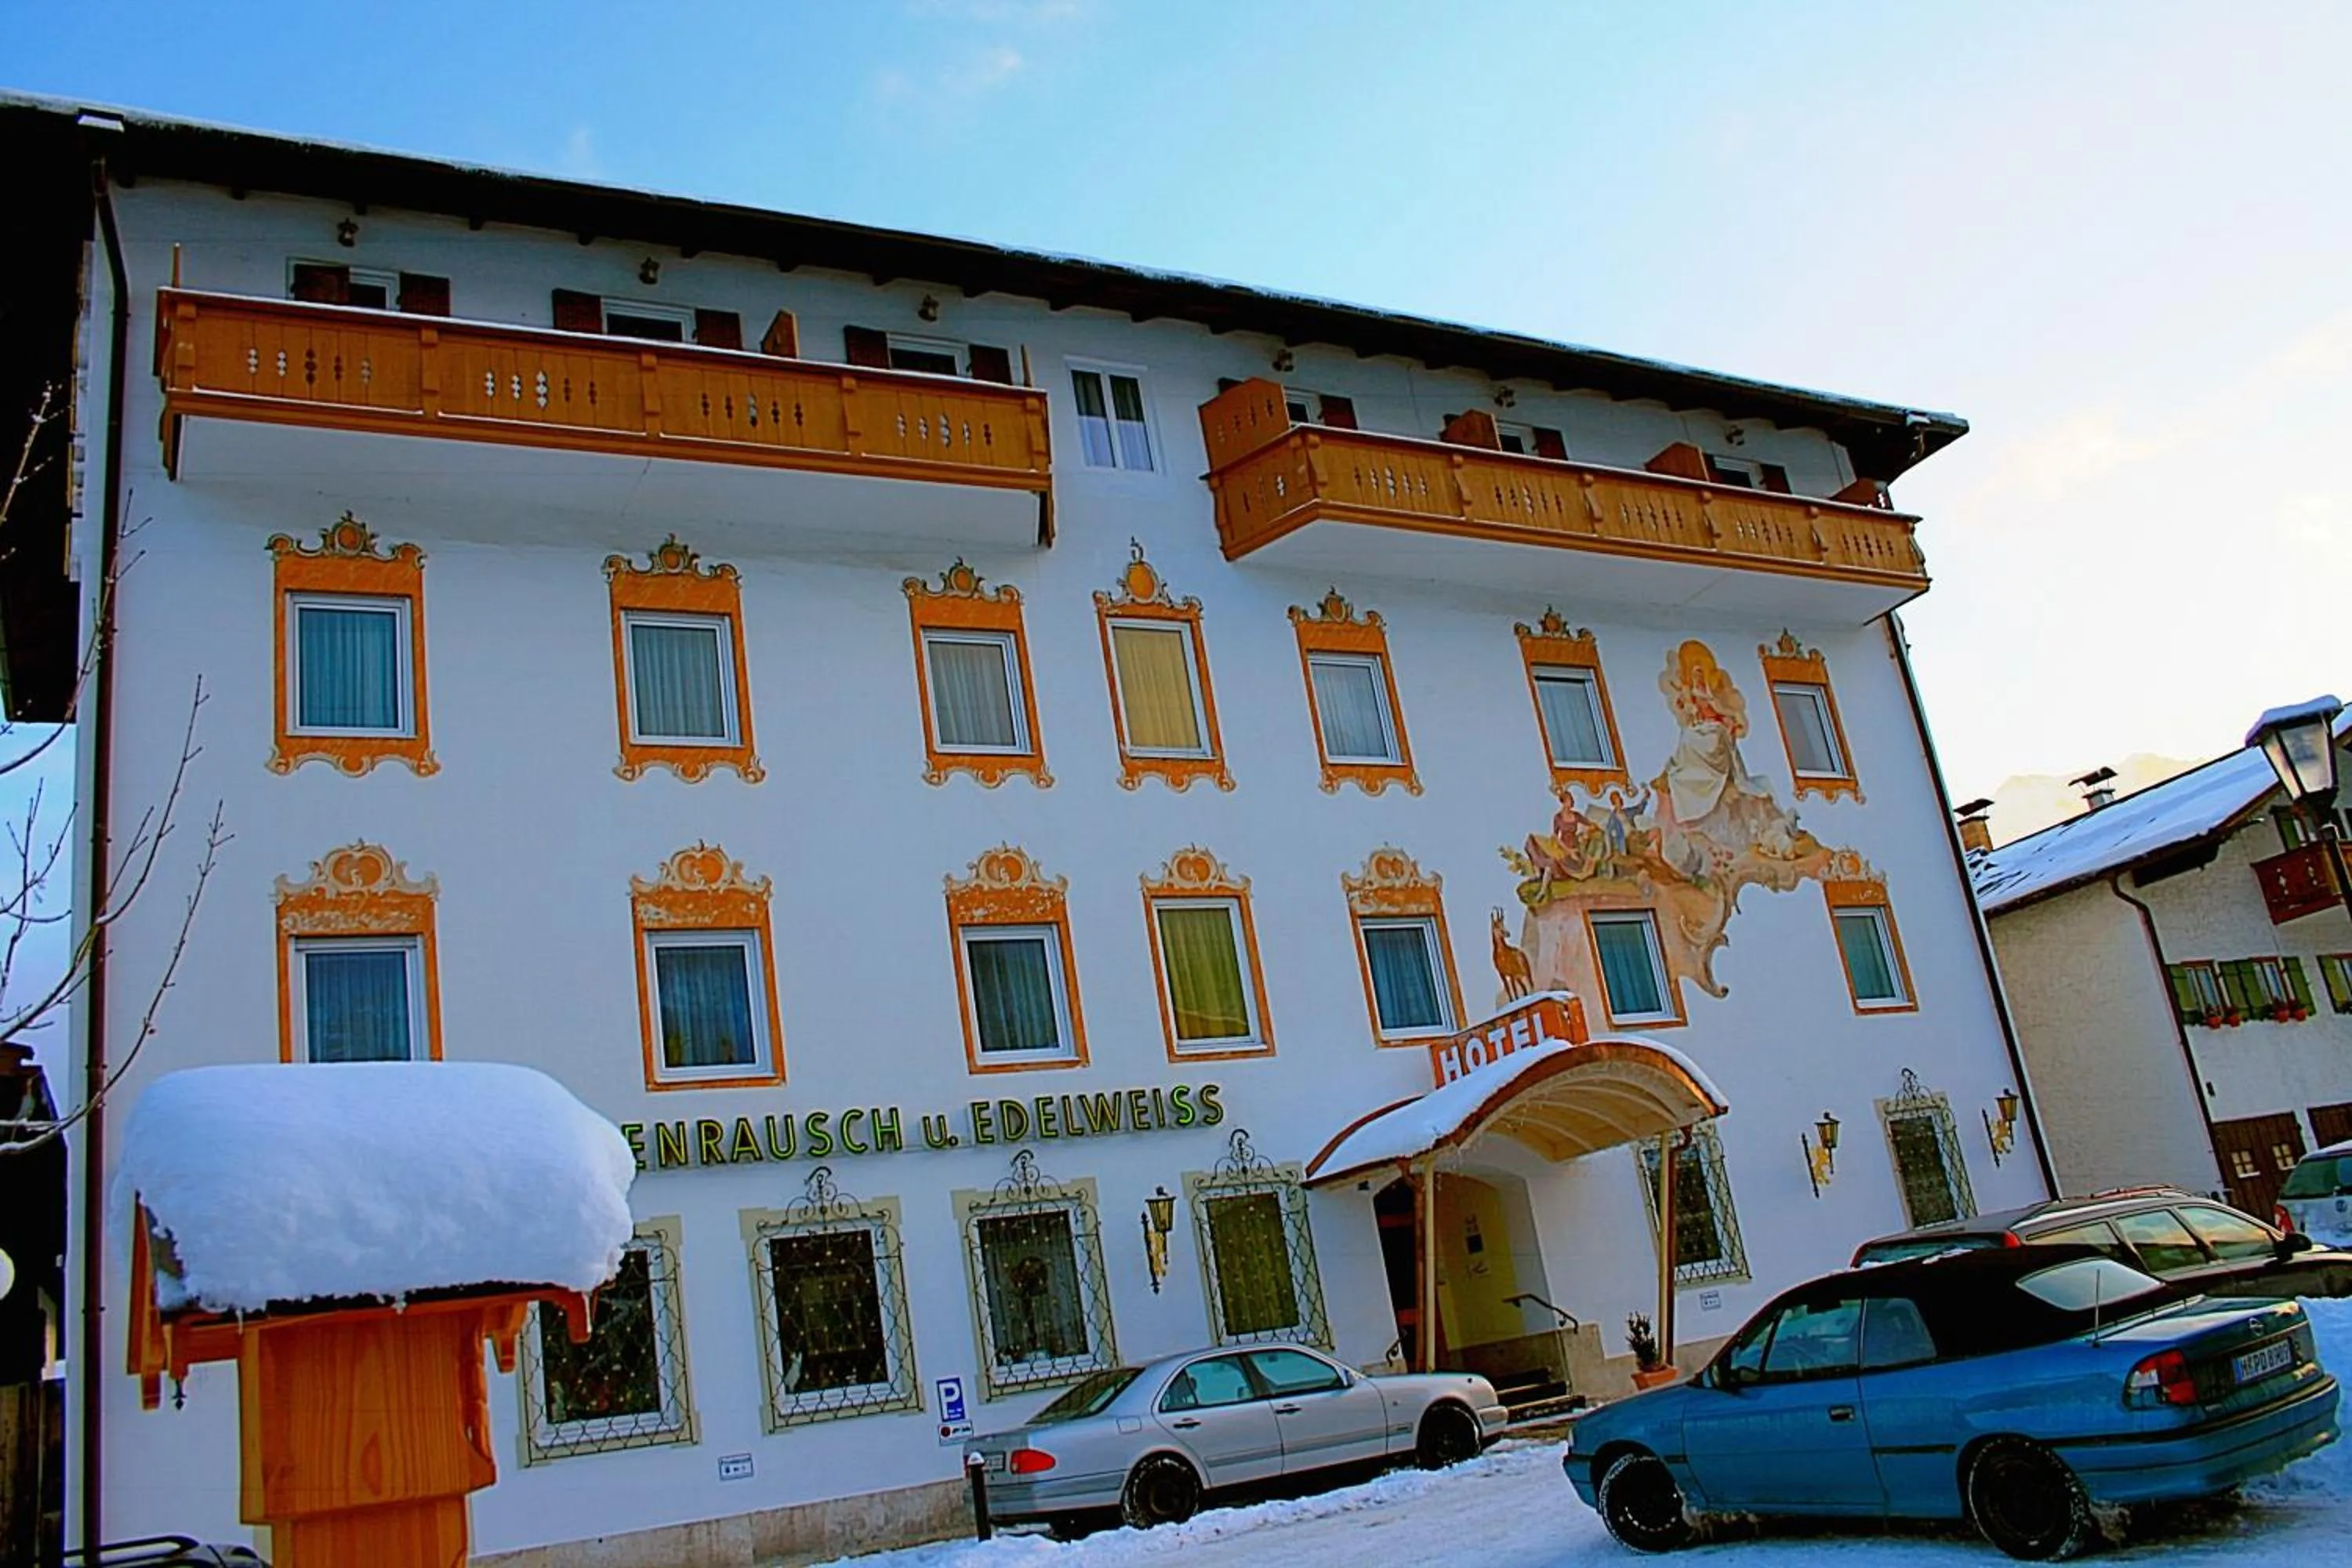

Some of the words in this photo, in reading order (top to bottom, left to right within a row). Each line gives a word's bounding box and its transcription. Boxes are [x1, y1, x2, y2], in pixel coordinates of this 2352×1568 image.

[1439, 1011, 1555, 1083] HOTEL
[971, 1084, 1224, 1145] EDELWEISS
[939, 1382, 960, 1421] P
